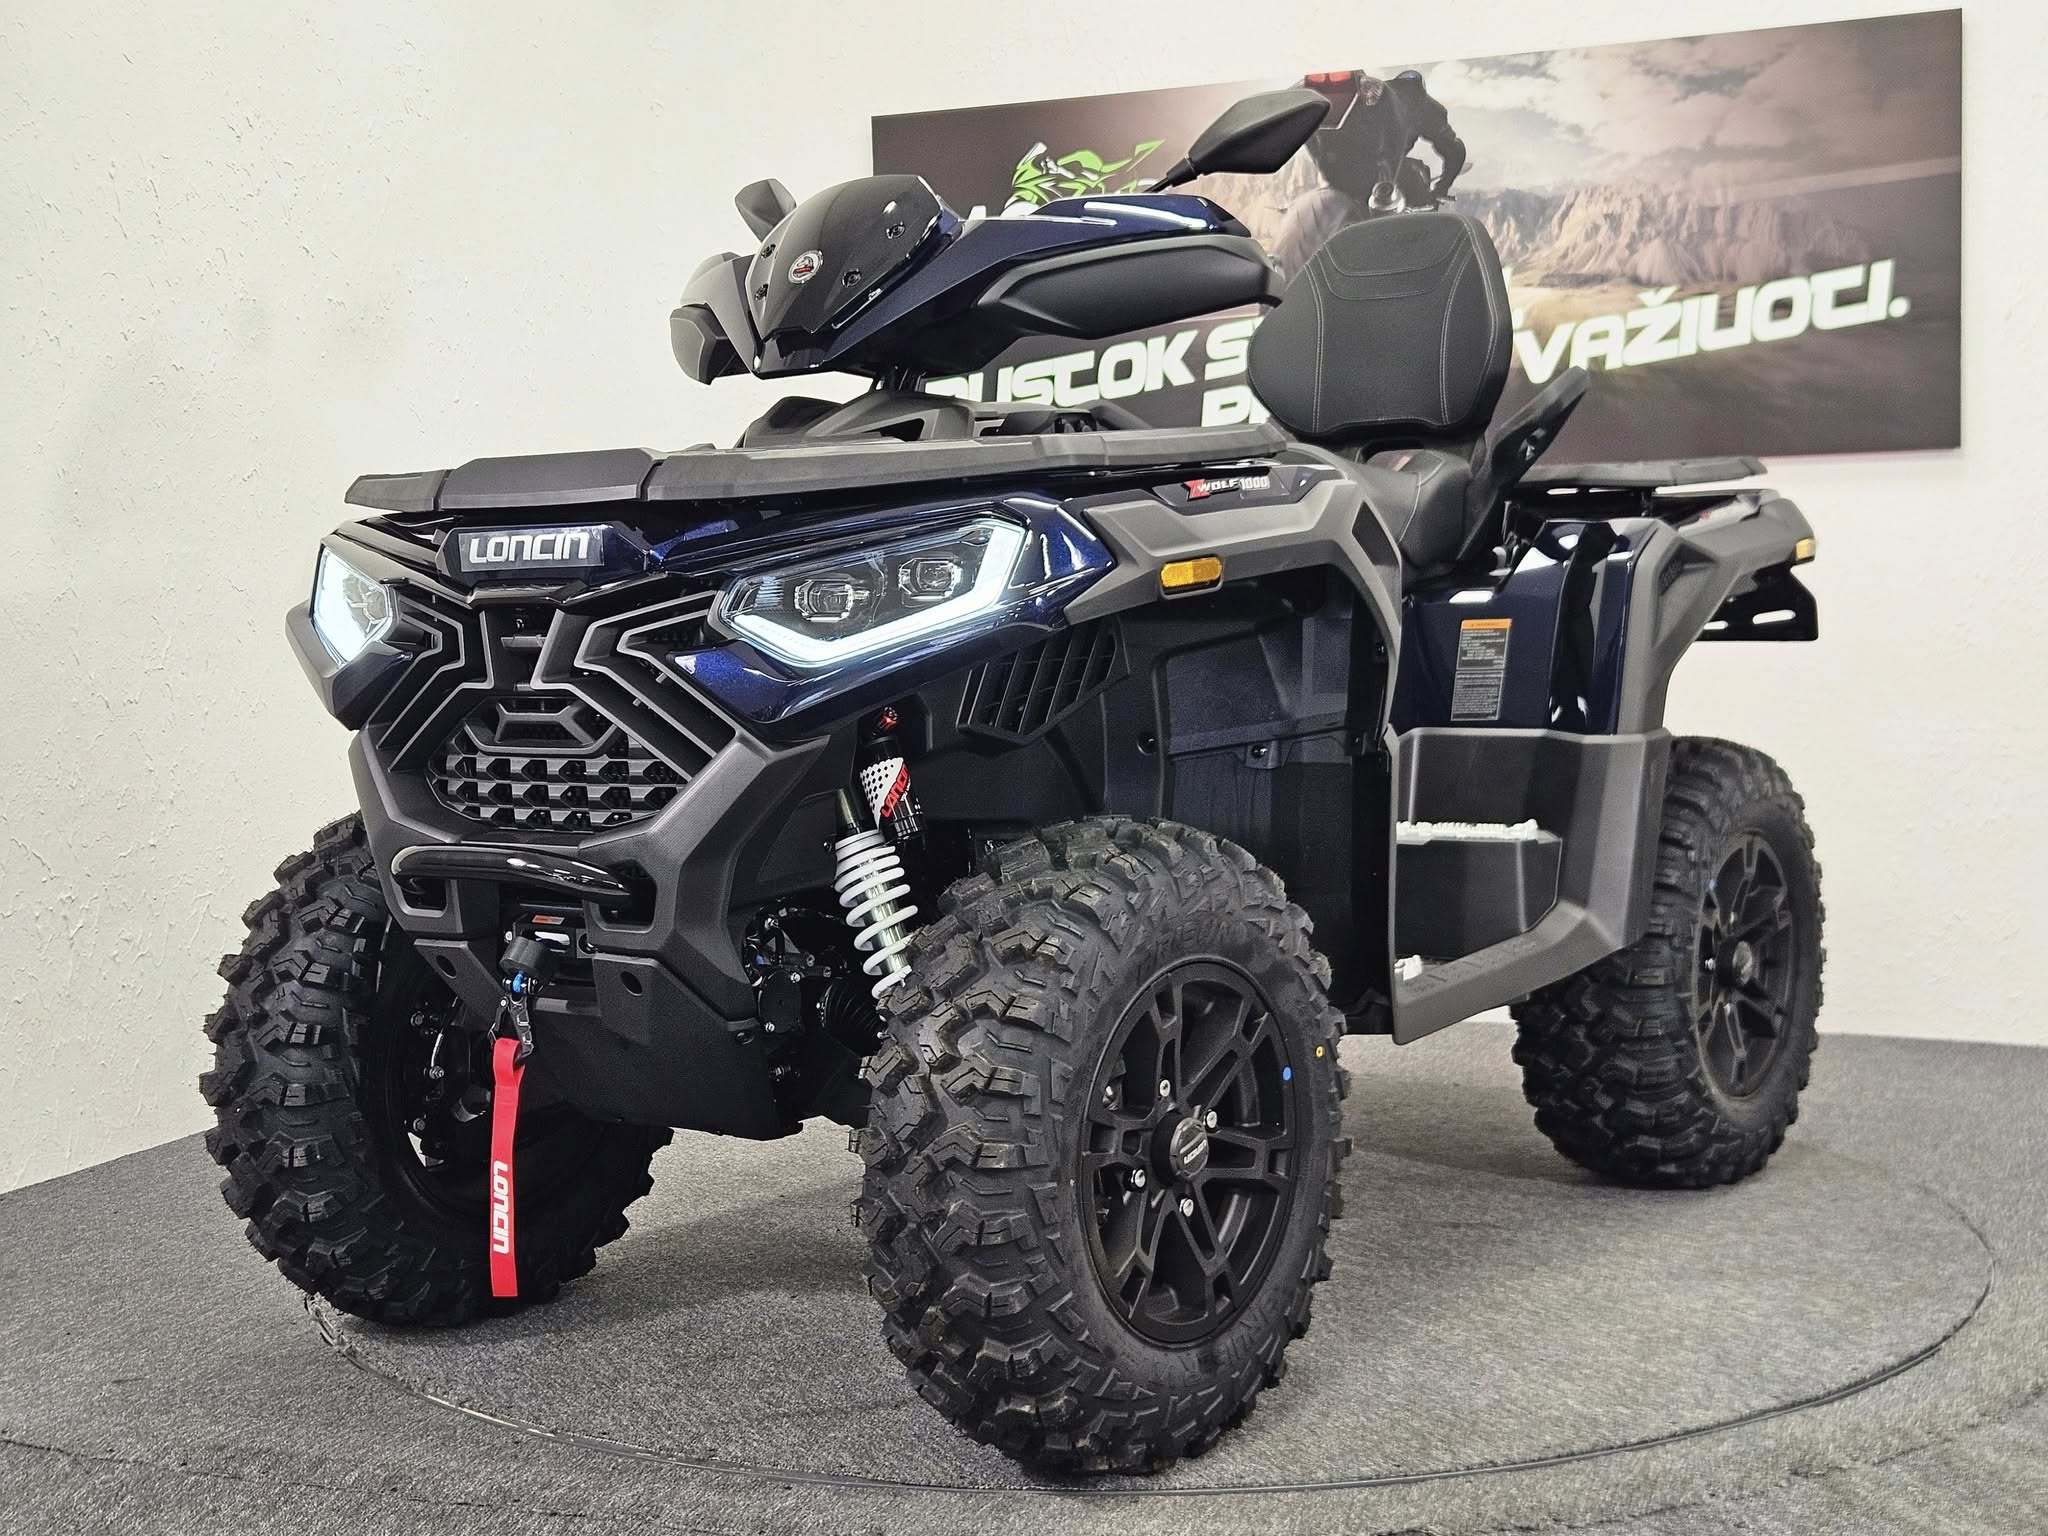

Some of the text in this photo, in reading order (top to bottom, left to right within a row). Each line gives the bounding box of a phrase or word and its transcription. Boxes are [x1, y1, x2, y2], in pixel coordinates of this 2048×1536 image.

[1513, 258, 1911, 385] VAŽIUOTI.
[469, 531, 589, 564] LONCIN
[493, 1160, 509, 1254] LONCIN
